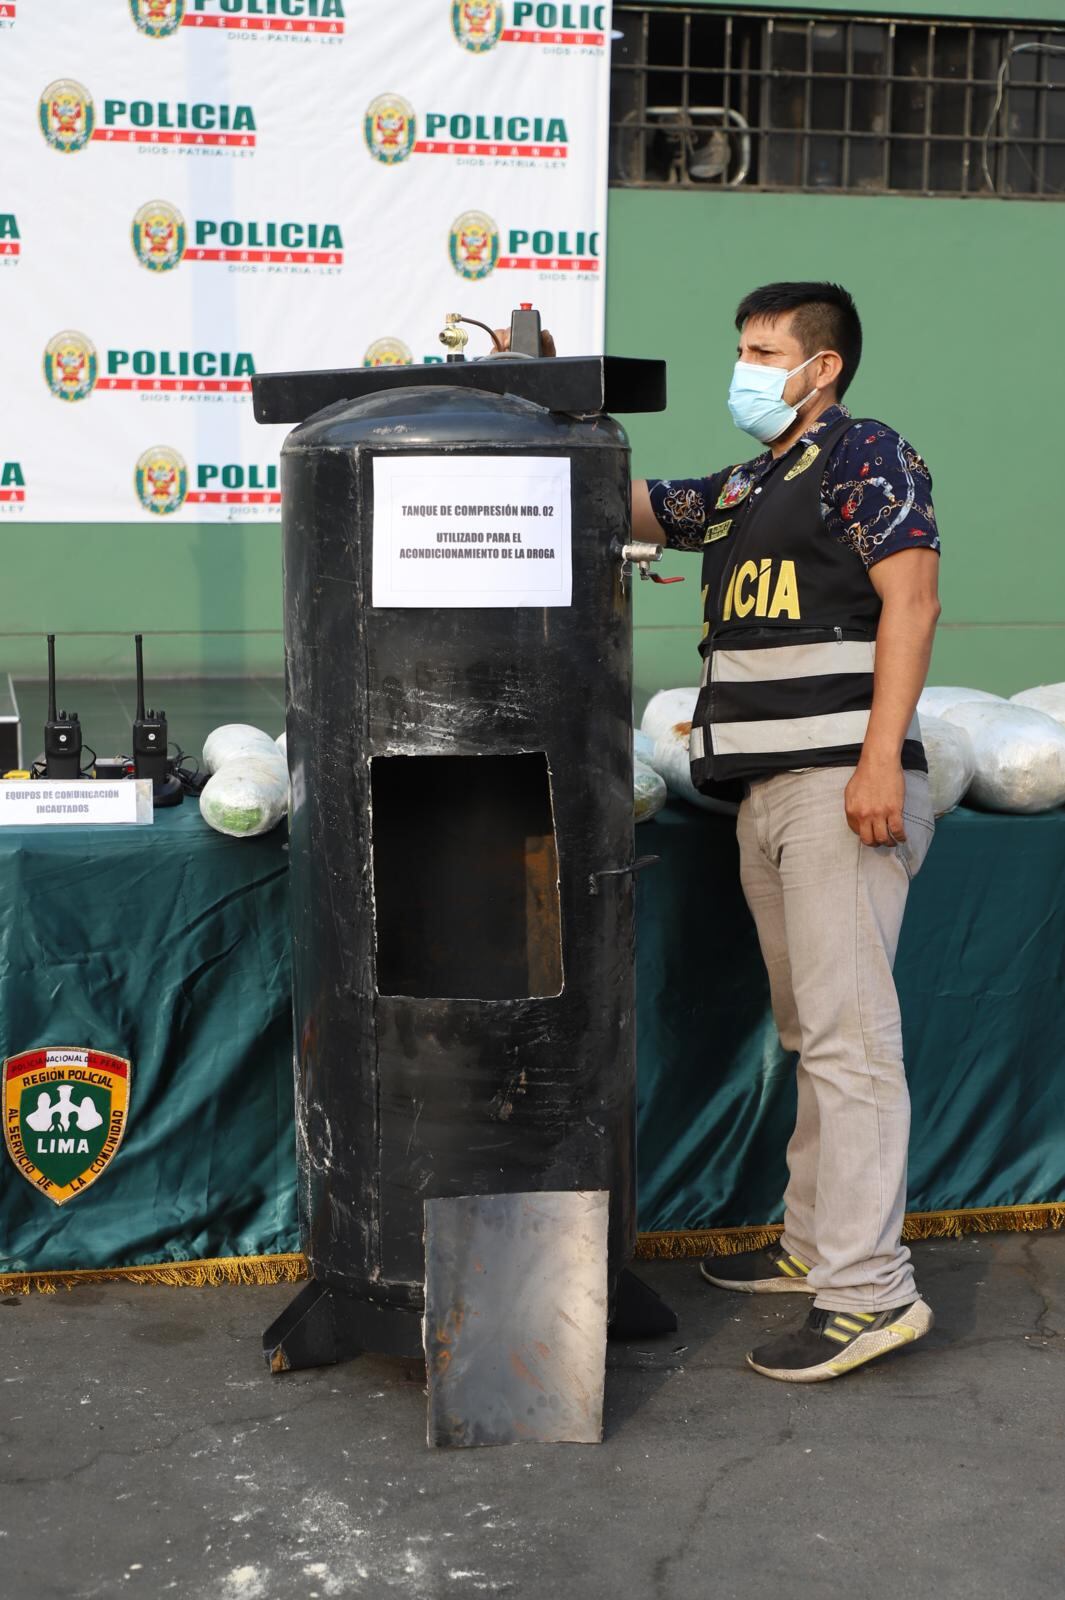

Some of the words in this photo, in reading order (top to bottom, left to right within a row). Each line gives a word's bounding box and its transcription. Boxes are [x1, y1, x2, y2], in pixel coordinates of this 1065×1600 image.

[195, 16, 338, 33] PERUANA
[104, 99, 257, 131] POLICIA
[425, 112, 568, 143] POLICIA
[105, 130, 249, 145] PERUANA
[426, 142, 561, 157] PERUANA
[196, 220, 344, 249] POLICIA
[196, 250, 337, 263] PERUANA
[107, 350, 256, 377] POLICIA
[109, 379, 250, 391] PERUANA
[197, 464, 277, 489] POLI
[199, 493, 272, 504] PERU
[401, 504, 438, 518] TANQUE
[440, 504, 453, 517] DE
[454, 503, 518, 517] COMPRESIÓN
[520, 504, 541, 517] NRO.
[542, 504, 554, 517] 02
[436, 532, 485, 543] UTILIZADO
[486, 532, 511, 543] PARA
[512, 532, 522, 543] EL
[399, 548, 499, 559] ACONDICIONAMIENTO
[501, 548, 513, 559] DE
[514, 548, 525, 559] LA
[526, 548, 555, 559] DROGA
[722, 558, 801, 622] ICÍA
[5, 790, 41, 801] EQUIPOS
[42, 790, 54, 800] DE
[36, 804, 90, 814] INCAUTADOS
[45, 1055, 83, 1063] NACIONAL
[67, 1069, 114, 1089] POLICIAL
[8, 1107, 19, 1123] AL
[9, 1125, 36, 1174] SERVICIO
[37, 1138, 90, 1154] LIMA
[89, 1109, 124, 1174] COMUNIDAD
[36, 1175, 54, 1191] DE
[69, 1176, 87, 1192] LA
